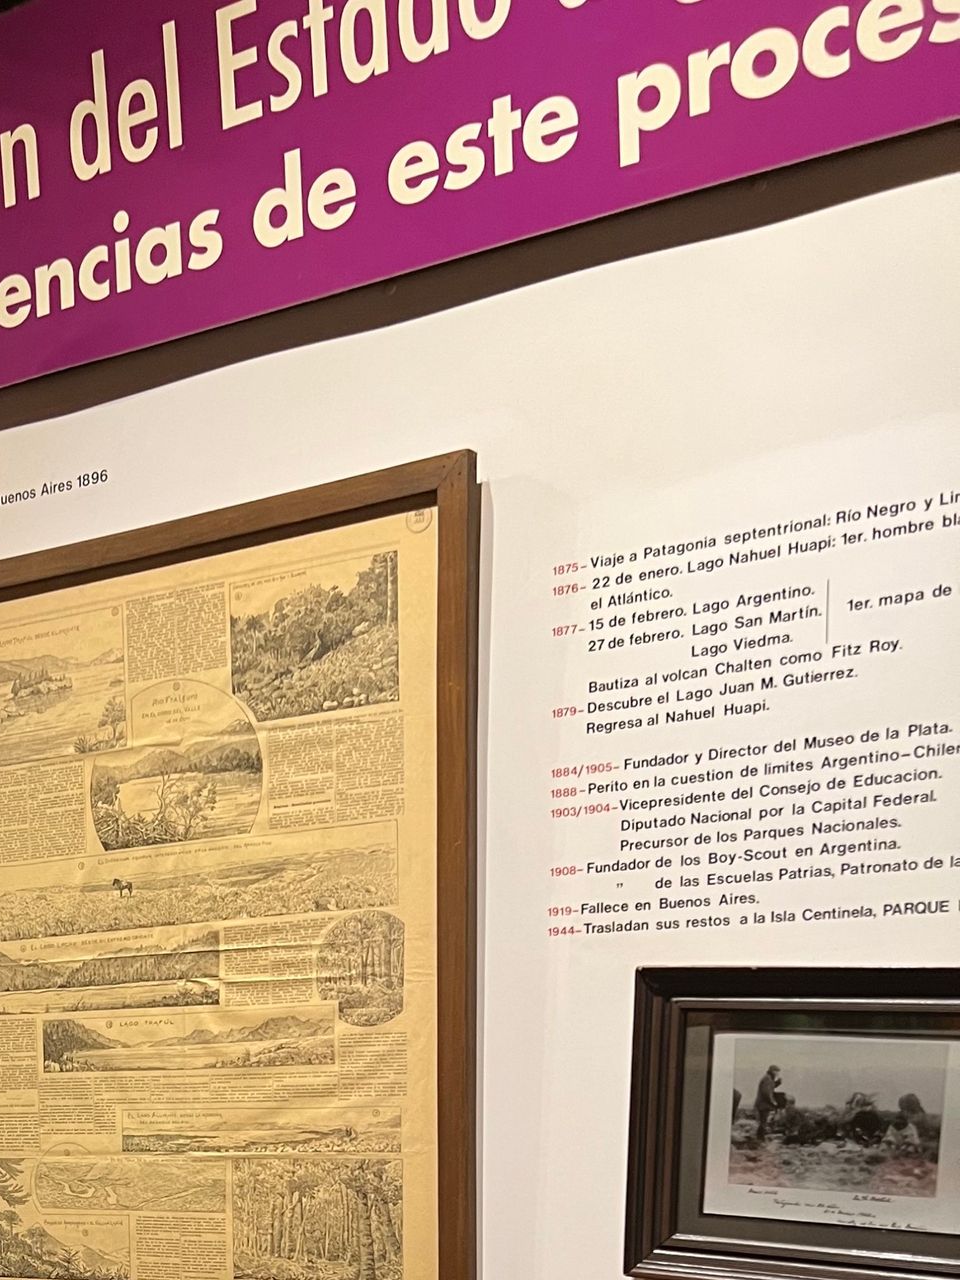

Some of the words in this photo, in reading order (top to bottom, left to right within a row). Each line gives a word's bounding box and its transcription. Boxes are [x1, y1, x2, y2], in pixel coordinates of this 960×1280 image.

[69, 21, 184, 183] del
[252, 148, 357, 249] de
[387, 94, 580, 205] este
[41, 481, 72, 496] Aires
[77, 470, 107, 487] 1896
[591, 554, 624, 568] Viaje
[629, 553, 637, 562] a
[644, 537, 716, 559] Patagonia
[724, 514, 831, 545] septentrional:
[836, 510, 861, 524] Río
[867, 501, 916, 518] Negro
[925, 498, 932, 511] y
[593, 576, 610, 589] 22
[616, 573, 632, 585] de
[639, 567, 682, 581] enero.
[688, 559, 723, 573] Lago
[730, 545, 780, 565] Nahuel
[789, 536, 835, 555] Huapi:
[841, 533, 866, 544] 1er.
[873, 521, 934, 539] hombre
[589, 618, 603, 630] 15
[609, 616, 625, 627] de
[632, 608, 686, 624] febrero.
[693, 601, 729, 614] Lago
[736, 587, 814, 607] Argentino.
[848, 600, 872, 611] 1er.
[879, 591, 924, 606] mapa
[933, 584, 952, 597] de
[589, 639, 605, 652] 27
[608, 637, 624, 649] de
[630, 630, 683, 645] febrero.
[693, 622, 727, 635] Lago
[735, 616, 762, 629] San
[589, 678, 638, 693] Bautiza
[645, 673, 657, 685] al
[662, 668, 707, 682] volcan
[715, 659, 771, 675] Chalten
[780, 652, 822, 665] como
[832, 645, 861, 658] Fitz
[870, 640, 902, 652] Roy.
[588, 696, 652, 713] Descubre
[658, 692, 669, 704] el
[677, 689, 712, 701] Lago
[720, 683, 754, 695] Juan
[761, 677, 777, 689] M.
[783, 669, 857, 686] Gutierrez.
[624, 753, 688, 770] Fundador
[695, 753, 702, 765] y
[709, 745, 767, 760] Director
[774, 739, 796, 752] del
[804, 735, 854, 749] Museo
[861, 730, 879, 742] de
[886, 728, 899, 739] la
[908, 723, 952, 737] Plata.
[587, 859, 650, 873] Fundador
[655, 857, 672, 868] de
[681, 855, 700, 866] los
[709, 847, 786, 865] Boy-Scout
[795, 847, 813, 857] en
[820, 839, 900, 856] Argentina.
[581, 903, 628, 914] Fallece
[635, 902, 651, 911] en
[660, 898, 710, 909] Buenos
[719, 893, 759, 905] Aires.
[584, 920, 648, 934] Trasladan
[656, 920, 679, 930] sus
[686, 916, 730, 928] restos
[740, 916, 747, 924] a
[754, 912, 765, 923] la
[771, 911, 795, 922] Isla
[802, 906, 876, 921] Centinela,
[883, 900, 949, 916] PARQUE
